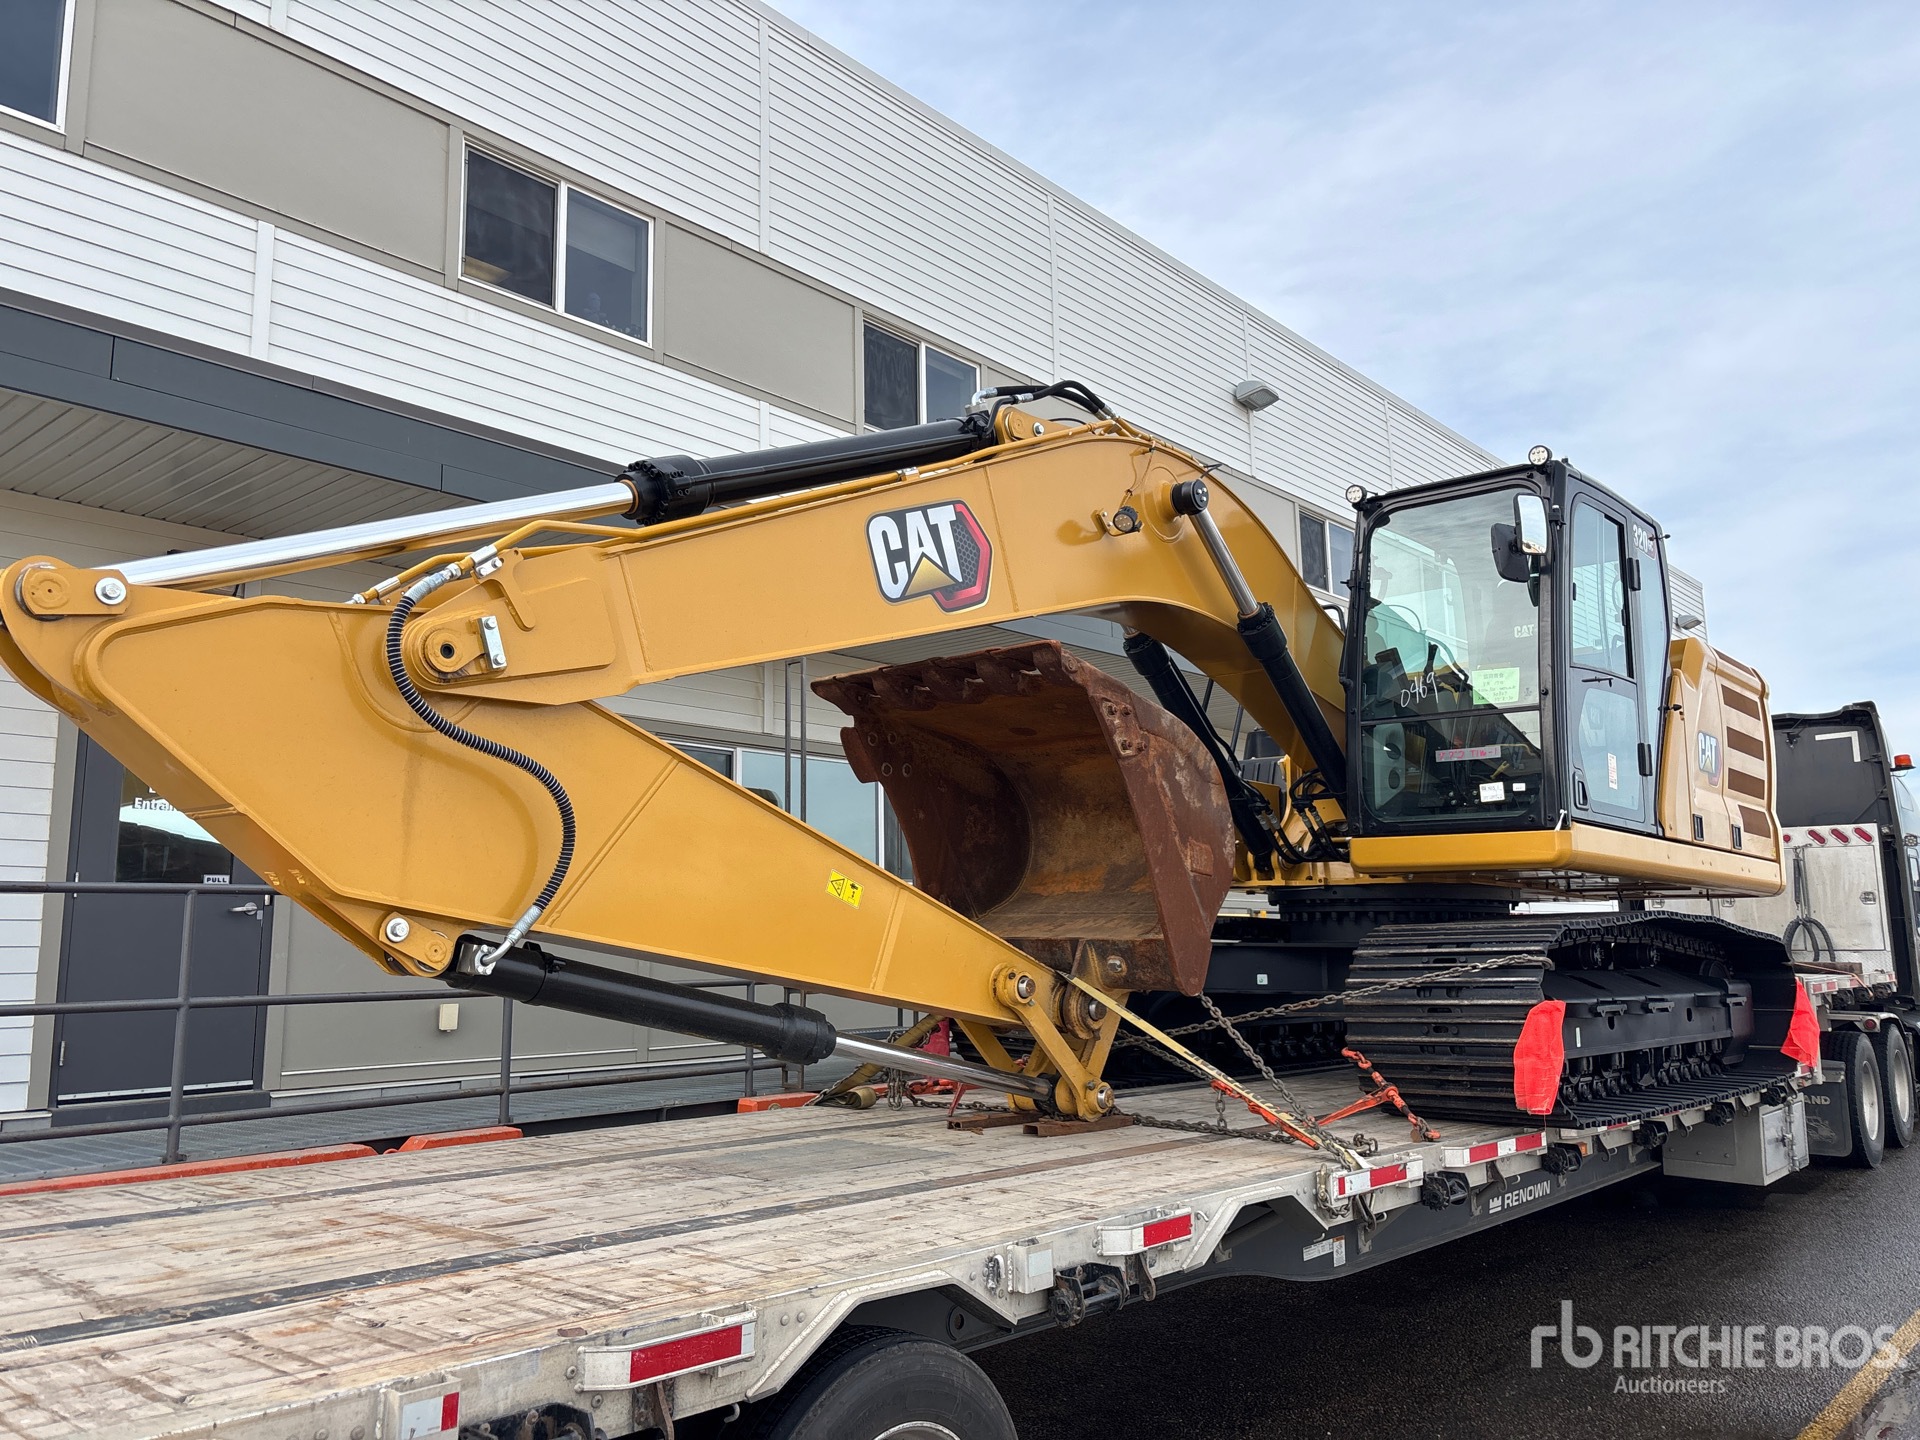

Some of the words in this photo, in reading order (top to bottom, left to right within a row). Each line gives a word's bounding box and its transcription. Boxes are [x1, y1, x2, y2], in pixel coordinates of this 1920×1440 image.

[868, 504, 963, 599] CAT
[1633, 524, 1648, 553] 320
[1514, 624, 1535, 638] CAT
[1400, 671, 1439, 708] 0469
[1698, 732, 1717, 774] CAT
[132, 797, 176, 811] Entran
[1804, 1094, 1831, 1105] AND
[1504, 1180, 1551, 1209] RENOWN
